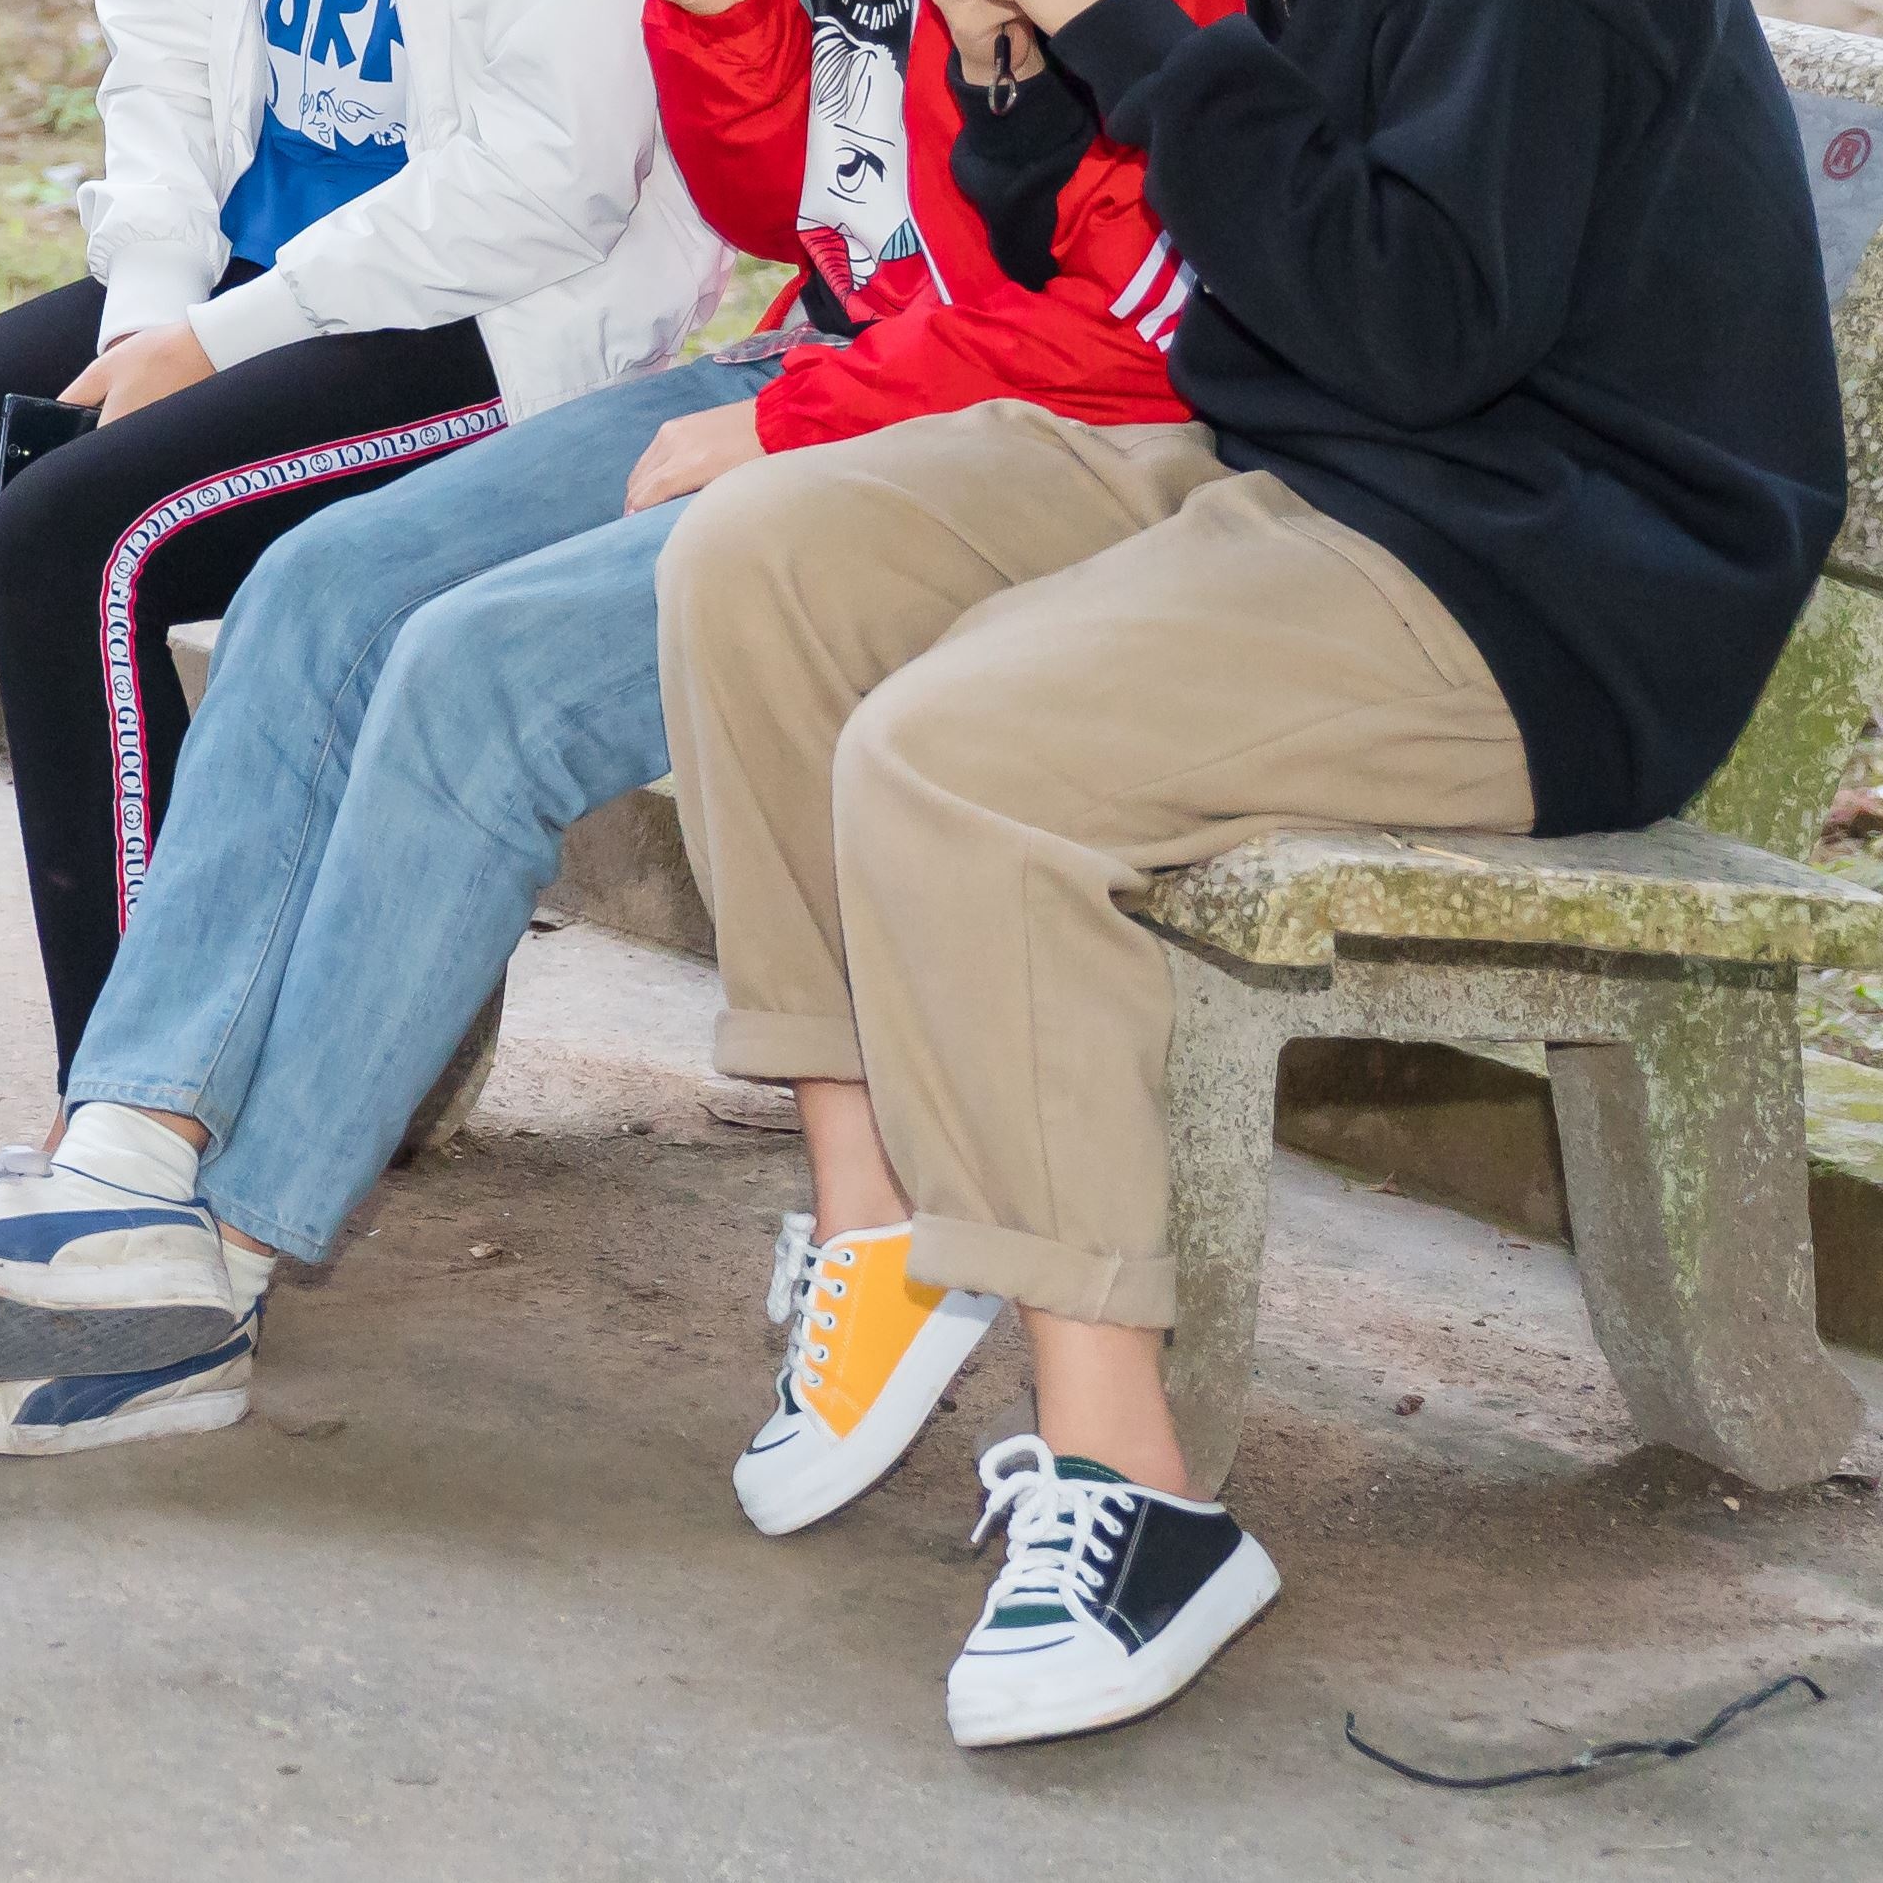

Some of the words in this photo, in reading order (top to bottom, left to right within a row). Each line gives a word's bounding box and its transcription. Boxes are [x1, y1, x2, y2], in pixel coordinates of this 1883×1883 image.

[444, 407, 507, 441] UCCI
[336, 432, 417, 468] GUCCI
[224, 459, 307, 500] GUCCI
[123, 499, 195, 559] GUCCI
[107, 580, 131, 669] GUCCI
[118, 706, 144, 799] GUCCI
